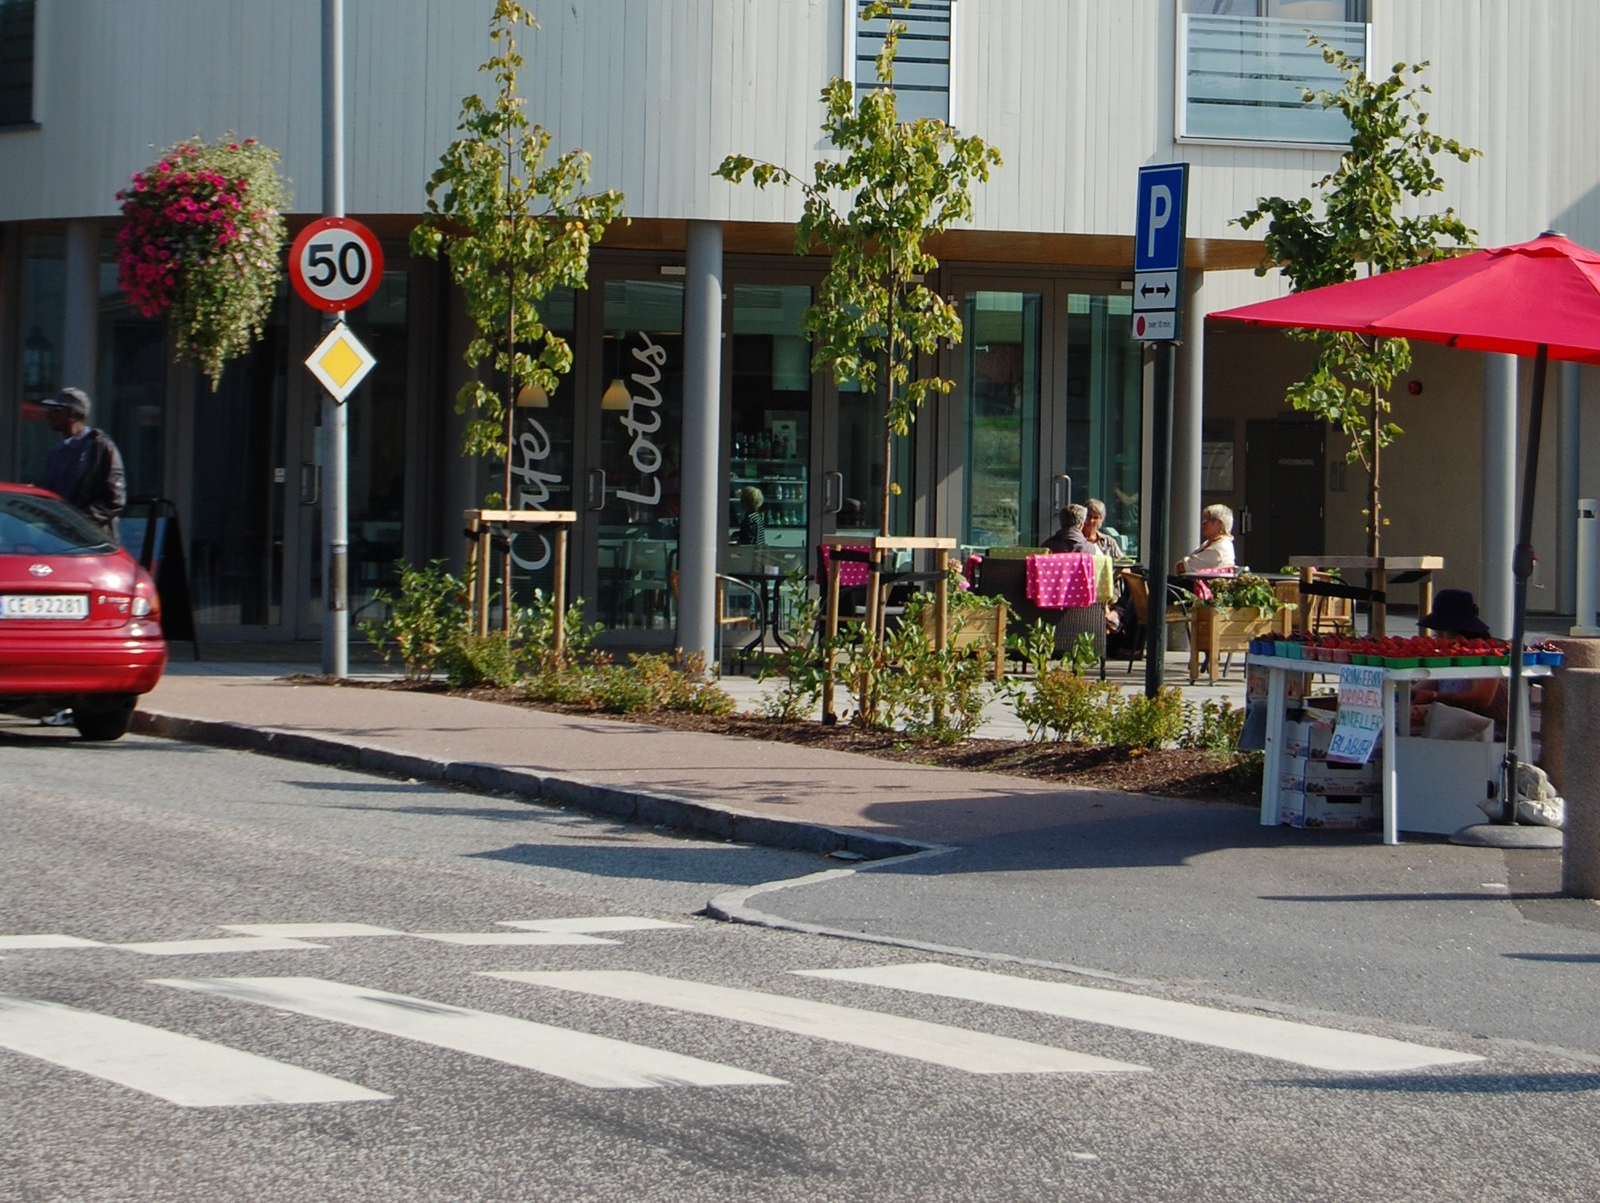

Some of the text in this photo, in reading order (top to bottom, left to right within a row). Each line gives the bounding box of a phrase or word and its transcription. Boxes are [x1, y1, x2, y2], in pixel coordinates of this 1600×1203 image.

[1148, 184, 1172, 258] P
[308, 241, 366, 288] 50
[616, 331, 667, 505] Lotus
[8, 598, 27, 613] CE
